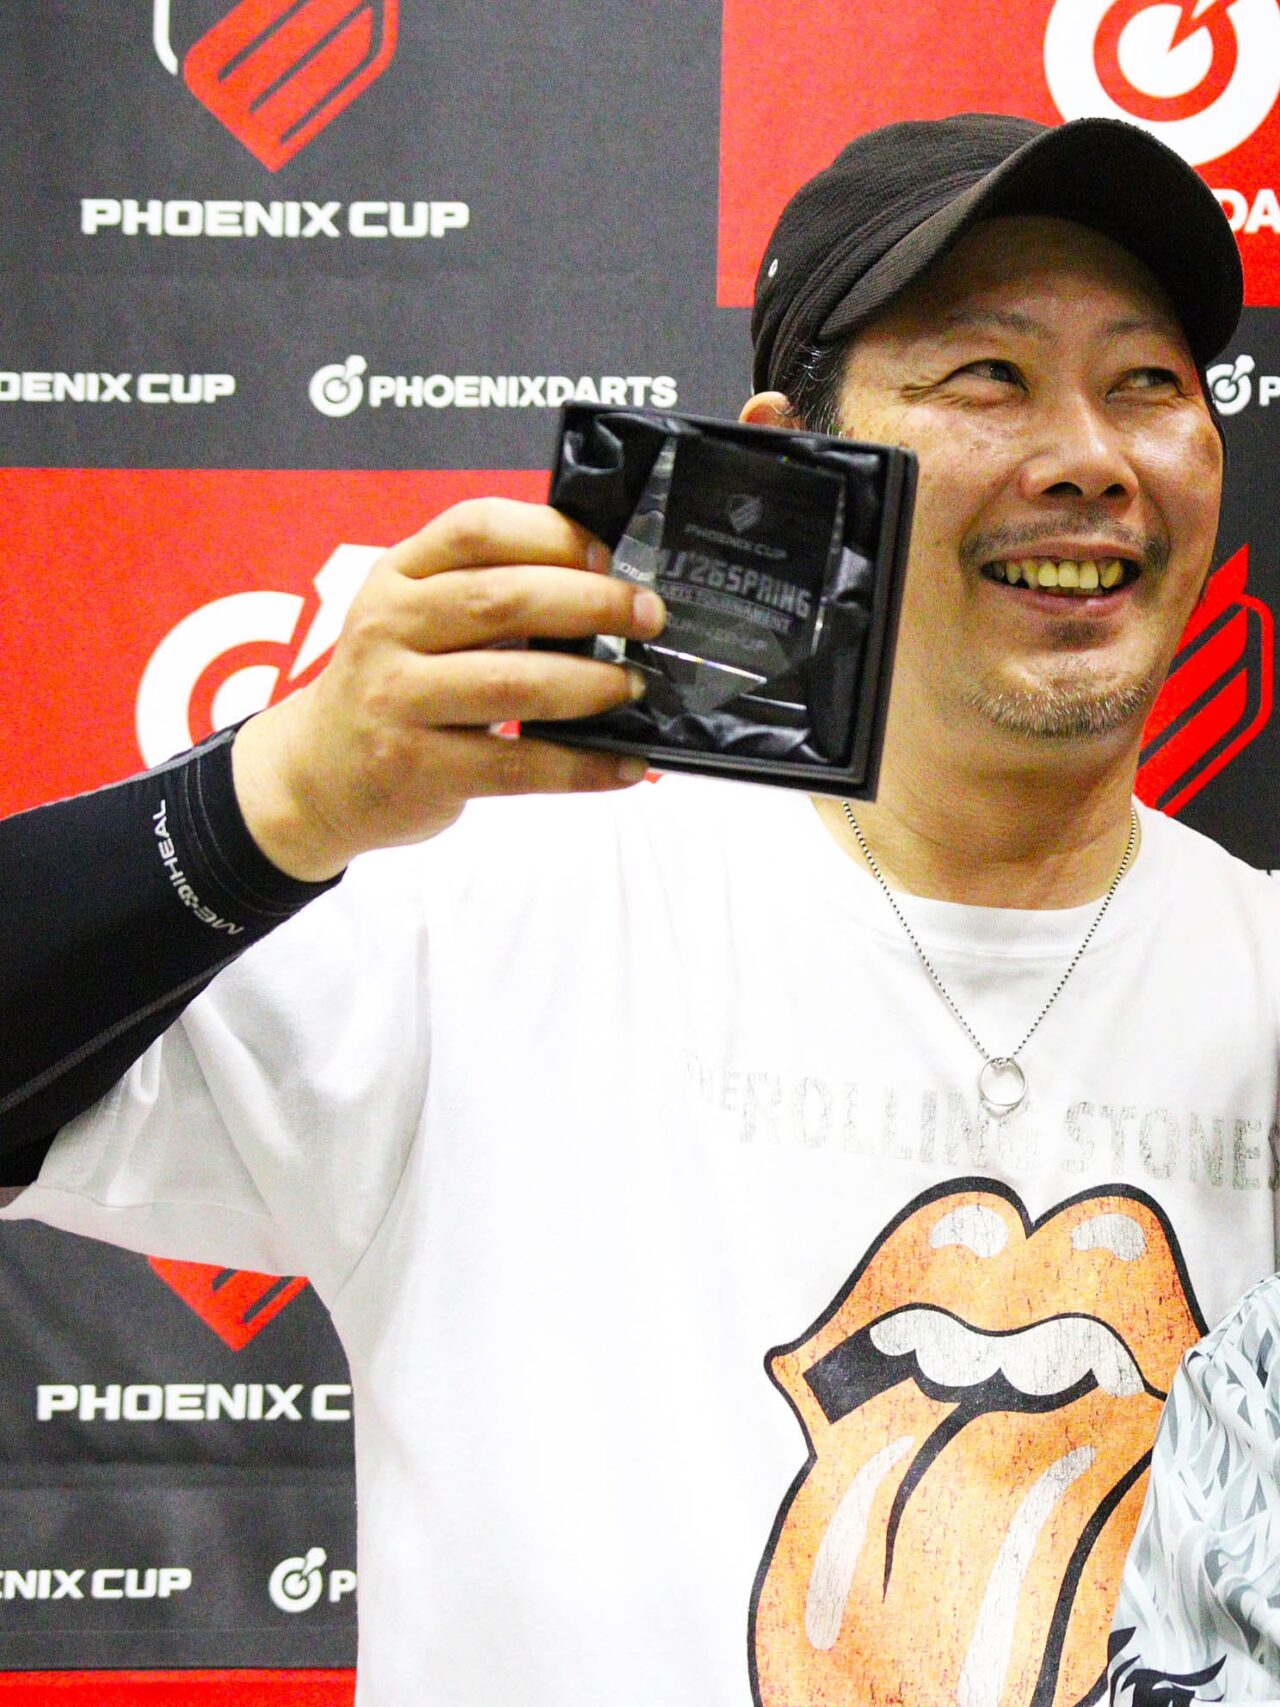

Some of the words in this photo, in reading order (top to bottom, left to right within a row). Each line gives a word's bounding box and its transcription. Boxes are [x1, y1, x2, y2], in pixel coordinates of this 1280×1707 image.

[80, 198, 342, 238] PHOENIX
[348, 200, 470, 239] CUP
[0, 371, 133, 403] OENIX
[137, 373, 236, 404] CUP
[368, 373, 678, 409] PHOENIXDARTS
[36, 1383, 303, 1421] PHOENIX
[311, 1384, 352, 1421] C
[0, 1569, 86, 1600] NIX
[91, 1567, 192, 1599] CUP
